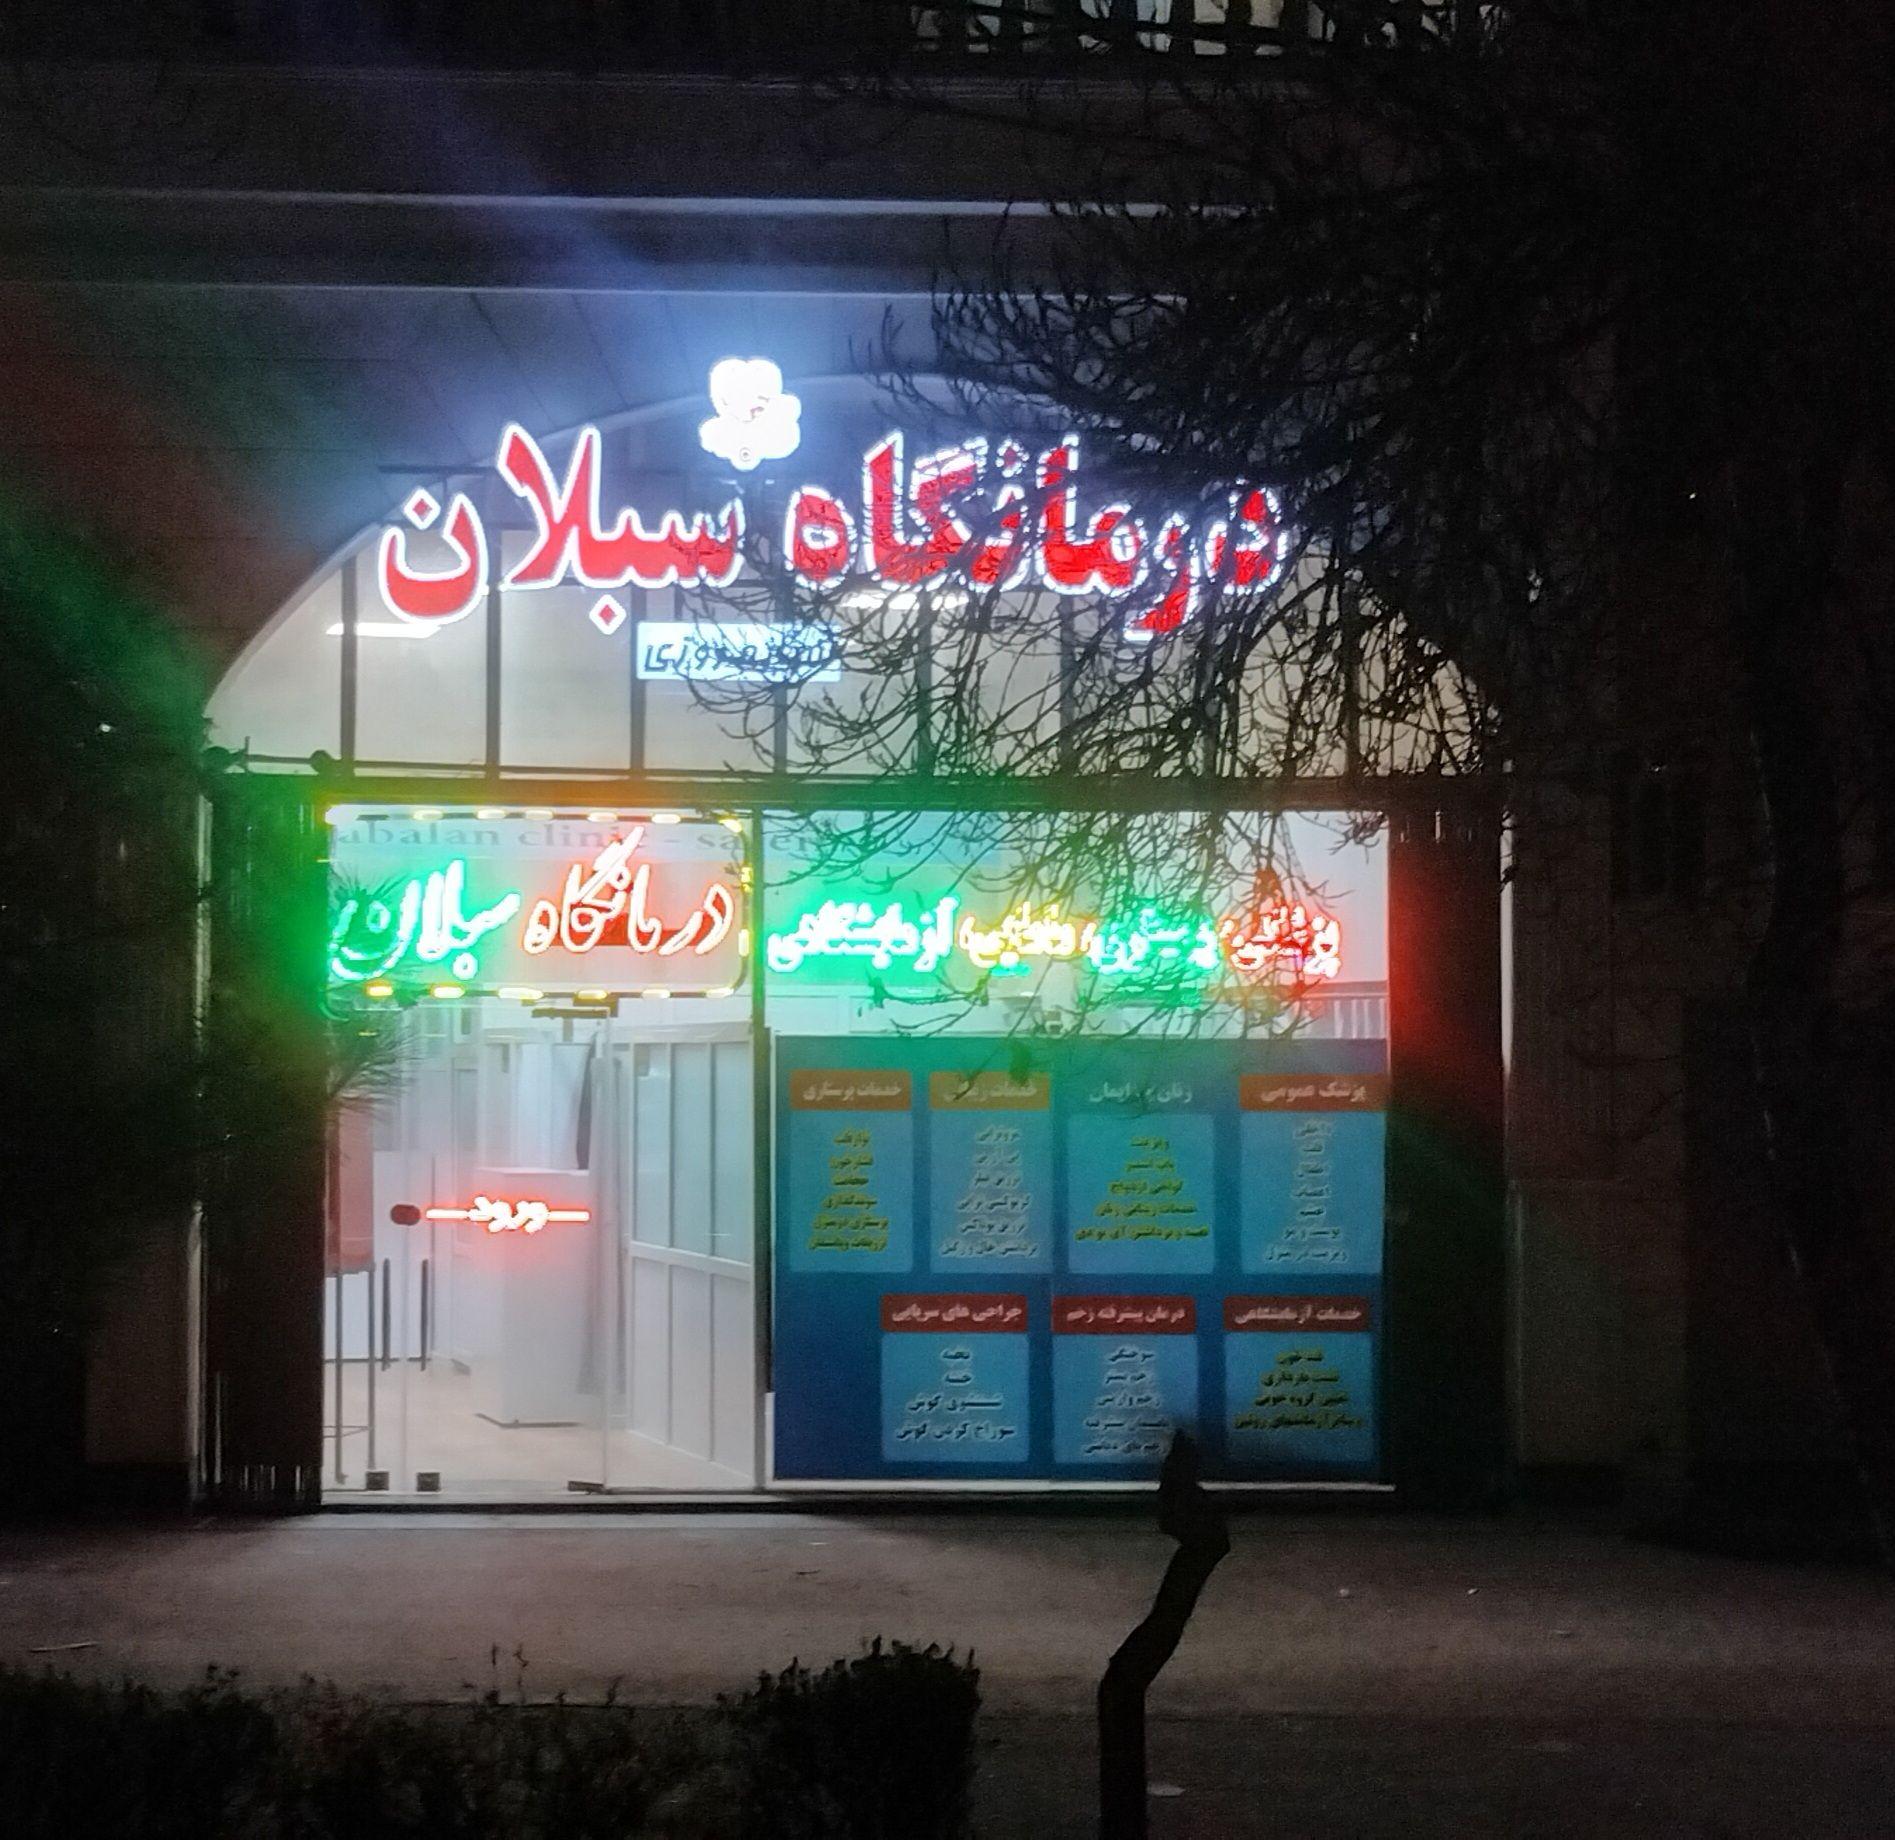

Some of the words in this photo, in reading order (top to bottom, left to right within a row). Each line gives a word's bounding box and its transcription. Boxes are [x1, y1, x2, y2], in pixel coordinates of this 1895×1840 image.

[377, 422, 746, 635] سبلان
[784, 432, 1289, 641] درمانگاه
[337, 818, 508, 847] abalan
[517, 823, 647, 850] clin
[524, 826, 734, 955] درمانگاه
[330, 859, 521, 980] سبلان
[941, 1303, 970, 1322] های
[972, 1303, 1023, 1323] جراحی
